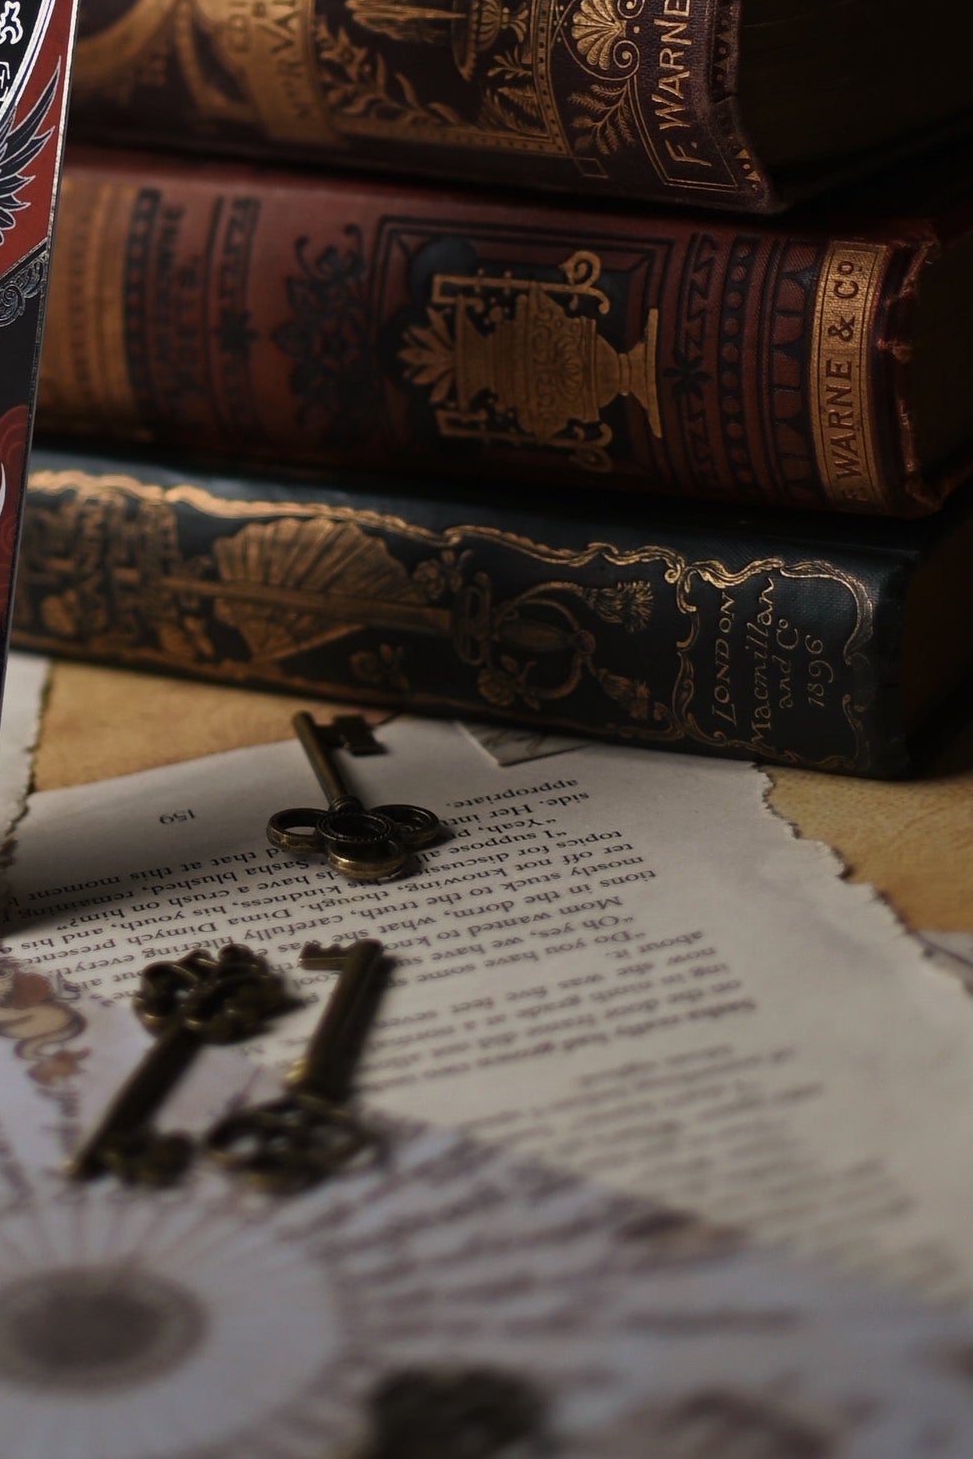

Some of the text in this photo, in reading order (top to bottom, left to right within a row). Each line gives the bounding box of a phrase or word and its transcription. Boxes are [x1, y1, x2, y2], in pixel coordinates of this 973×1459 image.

[665, 139, 713, 166] F.
[827, 315, 856, 343] &
[825, 358, 862, 479] WARNE
[711, 591, 737, 728] LONDON
[744, 577, 775, 748] Macmillan
[805, 634, 834, 708] 1896
[771, 655, 793, 709] and
[449, 781, 575, 806] appropriate.
[160, 810, 194, 823] 159
[29, 794, 588, 900] side. Her that at this moment
[451, 834, 535, 852] suppose
[18, 820, 555, 918] “Yeah, Sasha blushed, remaining
[572, 858, 642, 875] mostly
[22, 832, 621, 948] topics for kindness, his youth, and his
[259, 876, 307, 889] have
[470, 887, 492, 895] to
[502, 874, 559, 890] stuck
[129, 844, 631, 944] ter off not knowing, though. Dima Dimych
[169, 891, 229, 906] crush
[428, 893, 461, 904] the
[132, 902, 159, 911] on
[333, 871, 655, 945] tions in the dorm, what she
[351, 902, 417, 918] truth,
[437, 897, 621, 939] Mom wanted to
[57, 909, 122, 929] him?”
[246, 916, 342, 939] carefully
[433, 916, 632, 959] “Oh yes, we have
[546, 939, 585, 954] you
[641, 932, 701, 952] about
[487, 952, 538, 966] have
[418, 965, 474, 981] some
